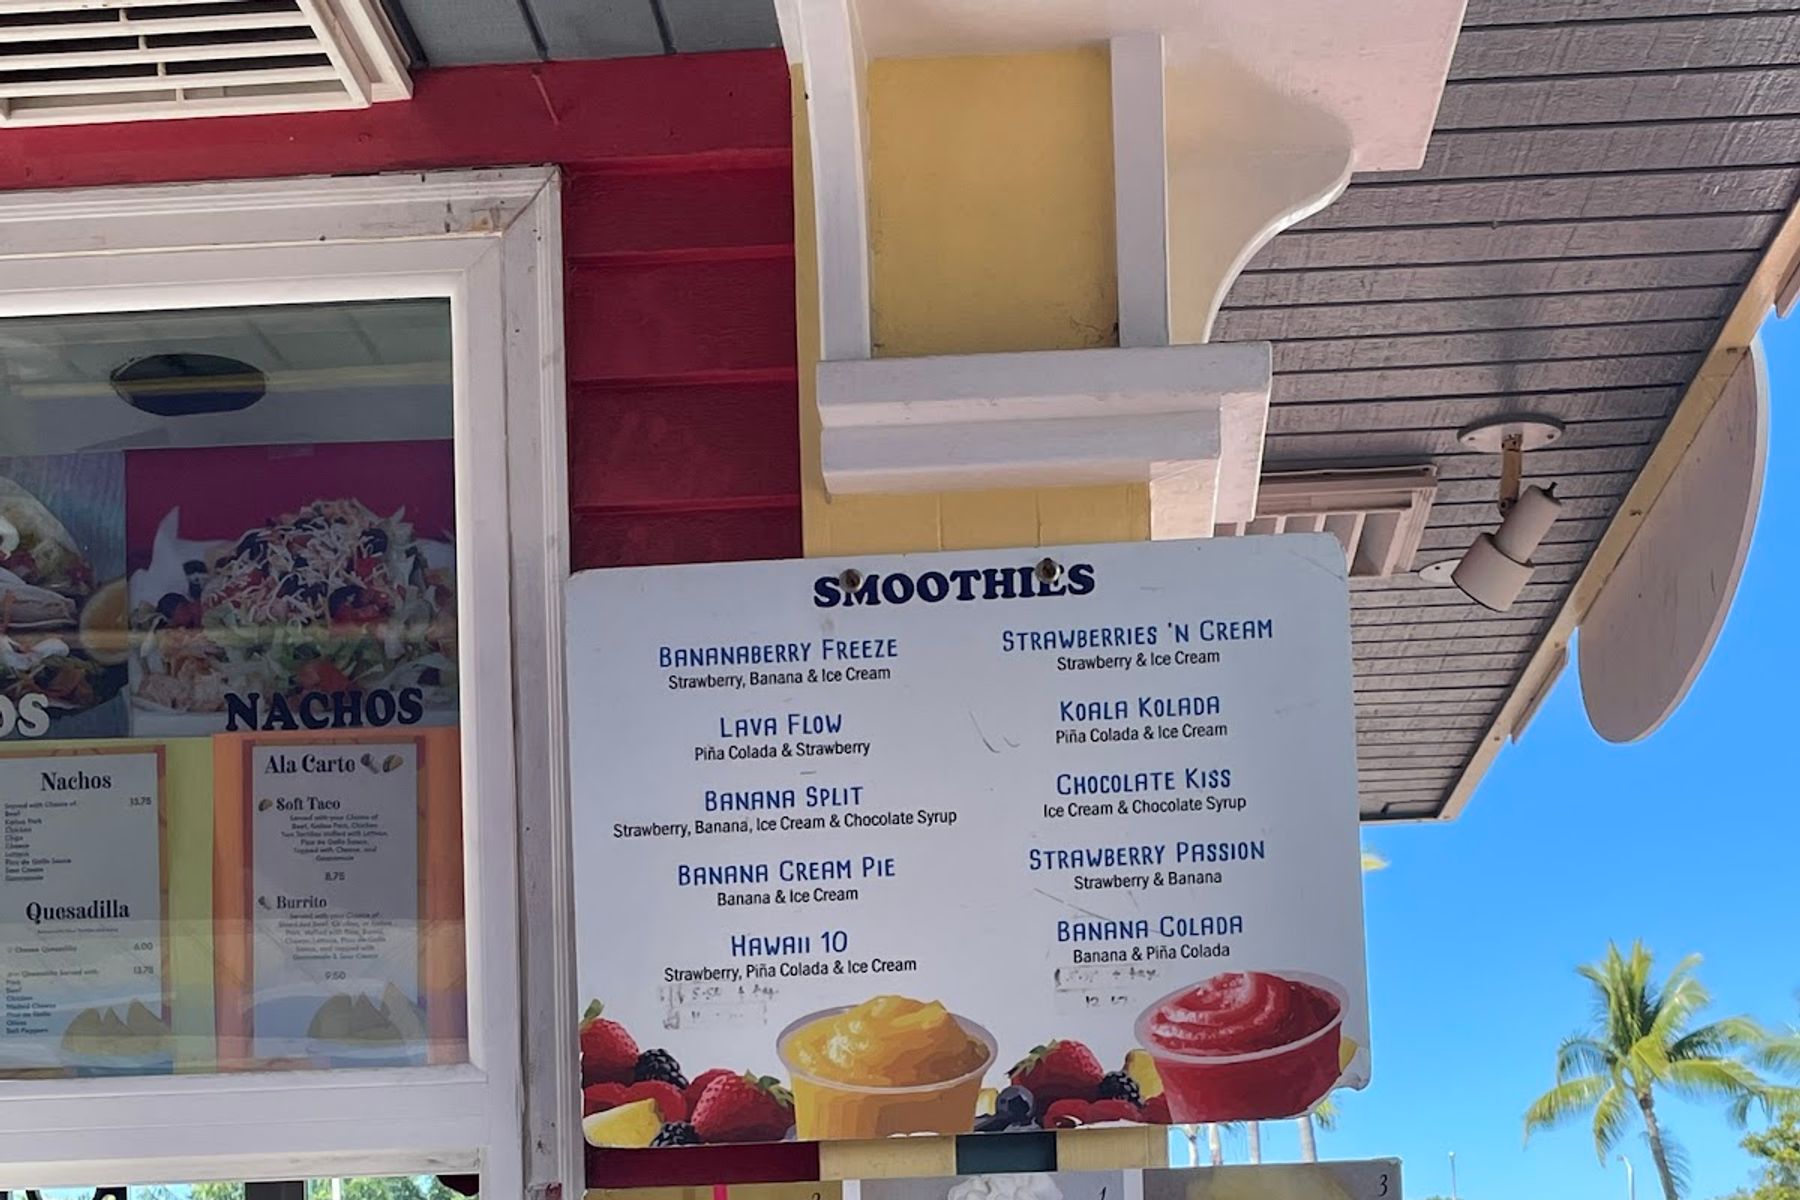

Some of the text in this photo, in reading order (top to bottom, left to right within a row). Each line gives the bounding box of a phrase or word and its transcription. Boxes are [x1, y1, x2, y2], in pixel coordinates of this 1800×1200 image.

[814, 563, 1095, 607] SMOOTHIES
[1058, 651, 1219, 670] Strawberry & Ice Cream
[669, 667, 890, 689] Strawberry, Banana & Ice Cream
[225, 688, 423, 731] NACHOS
[1056, 724, 1227, 743] Piña Colada & Ice Cream
[695, 742, 870, 760] Piña Colada & Strawberry
[265, 753, 356, 774] Ala Carte
[40, 769, 112, 791] Nachos
[276, 796, 341, 811] Soft Taco
[1044, 796, 1246, 818] Ice Cream & Chocolate Syrup
[614, 810, 956, 838] Strawberry, Banana, Ice Cream & Chocolate Syrup
[1075, 872, 1222, 890] Strawberry & Banana
[276, 895, 327, 909] Burrito
[718, 888, 858, 906] Banana & Ice Cream
[25, 900, 130, 924] Quesadilla
[1074, 944, 1229, 963] Banana & Piña Colada
[665, 959, 916, 982] Strawberry, Piña Colada & Ice Cream
[1378, 1174, 1389, 1196] 3
